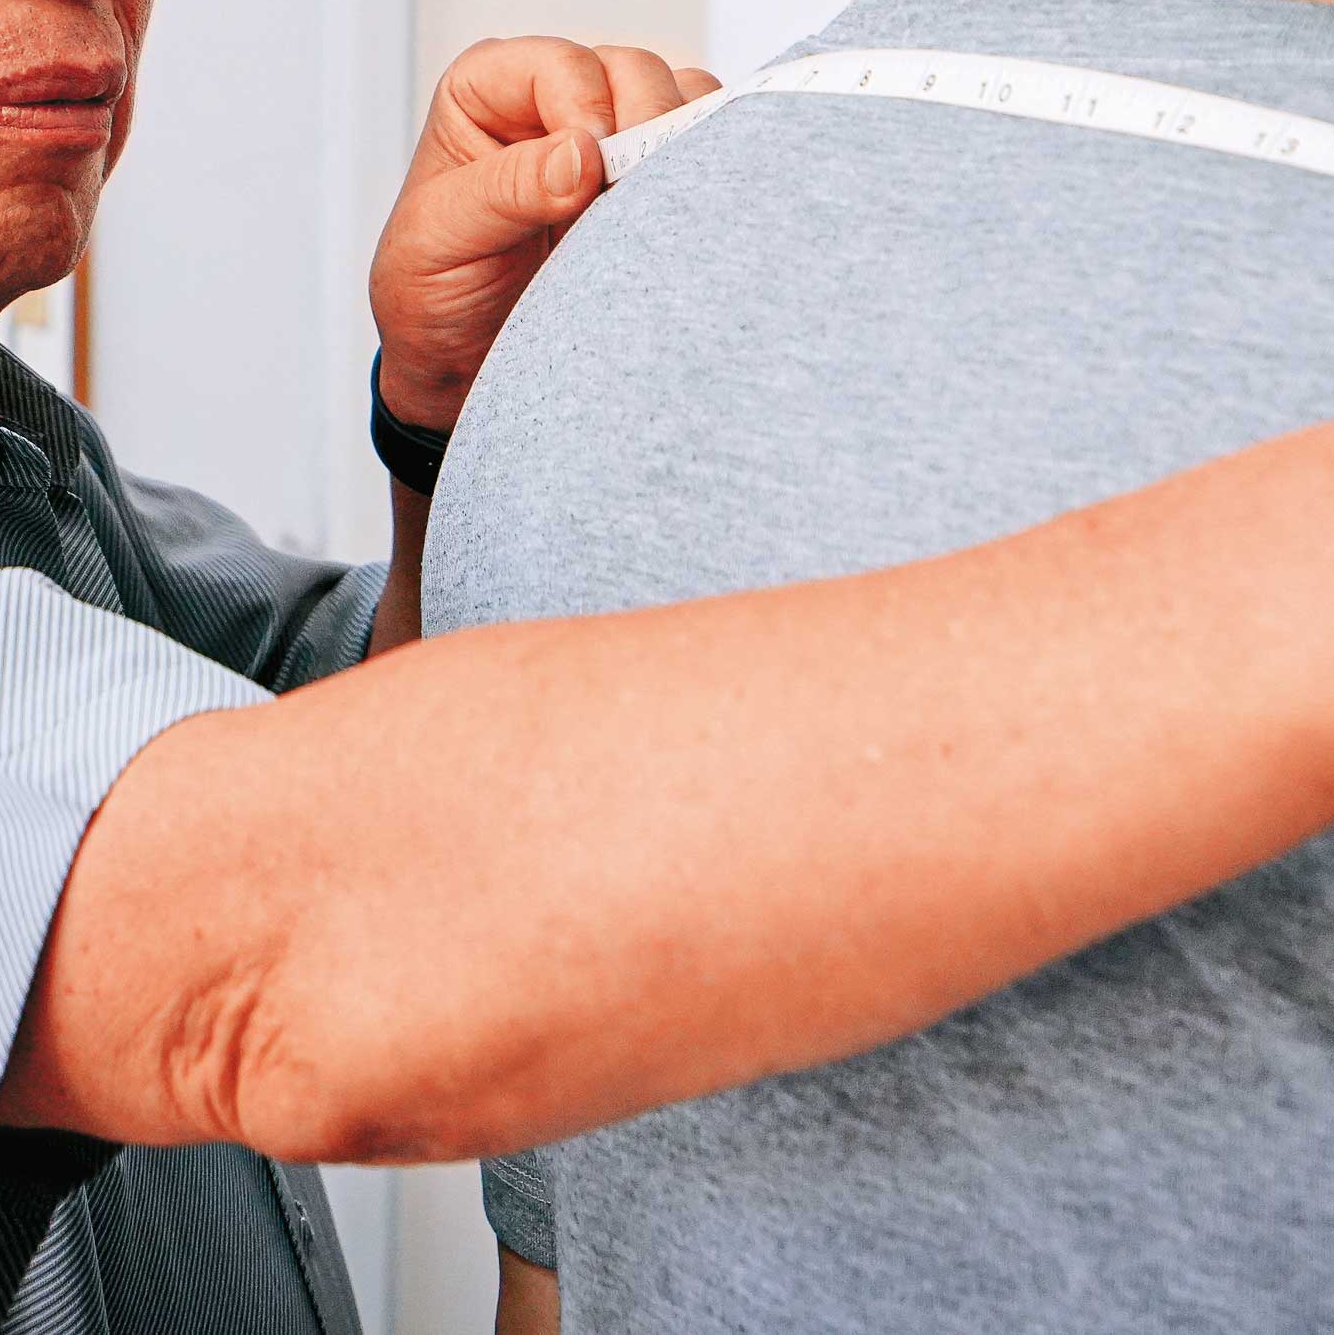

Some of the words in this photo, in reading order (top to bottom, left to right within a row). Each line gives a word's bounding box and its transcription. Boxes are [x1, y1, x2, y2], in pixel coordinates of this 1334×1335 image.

[923, 73, 937, 92] 9
[979, 81, 1013, 104] 10
[1063, 93, 1098, 118] 11
[1154, 110, 1197, 135] 12
